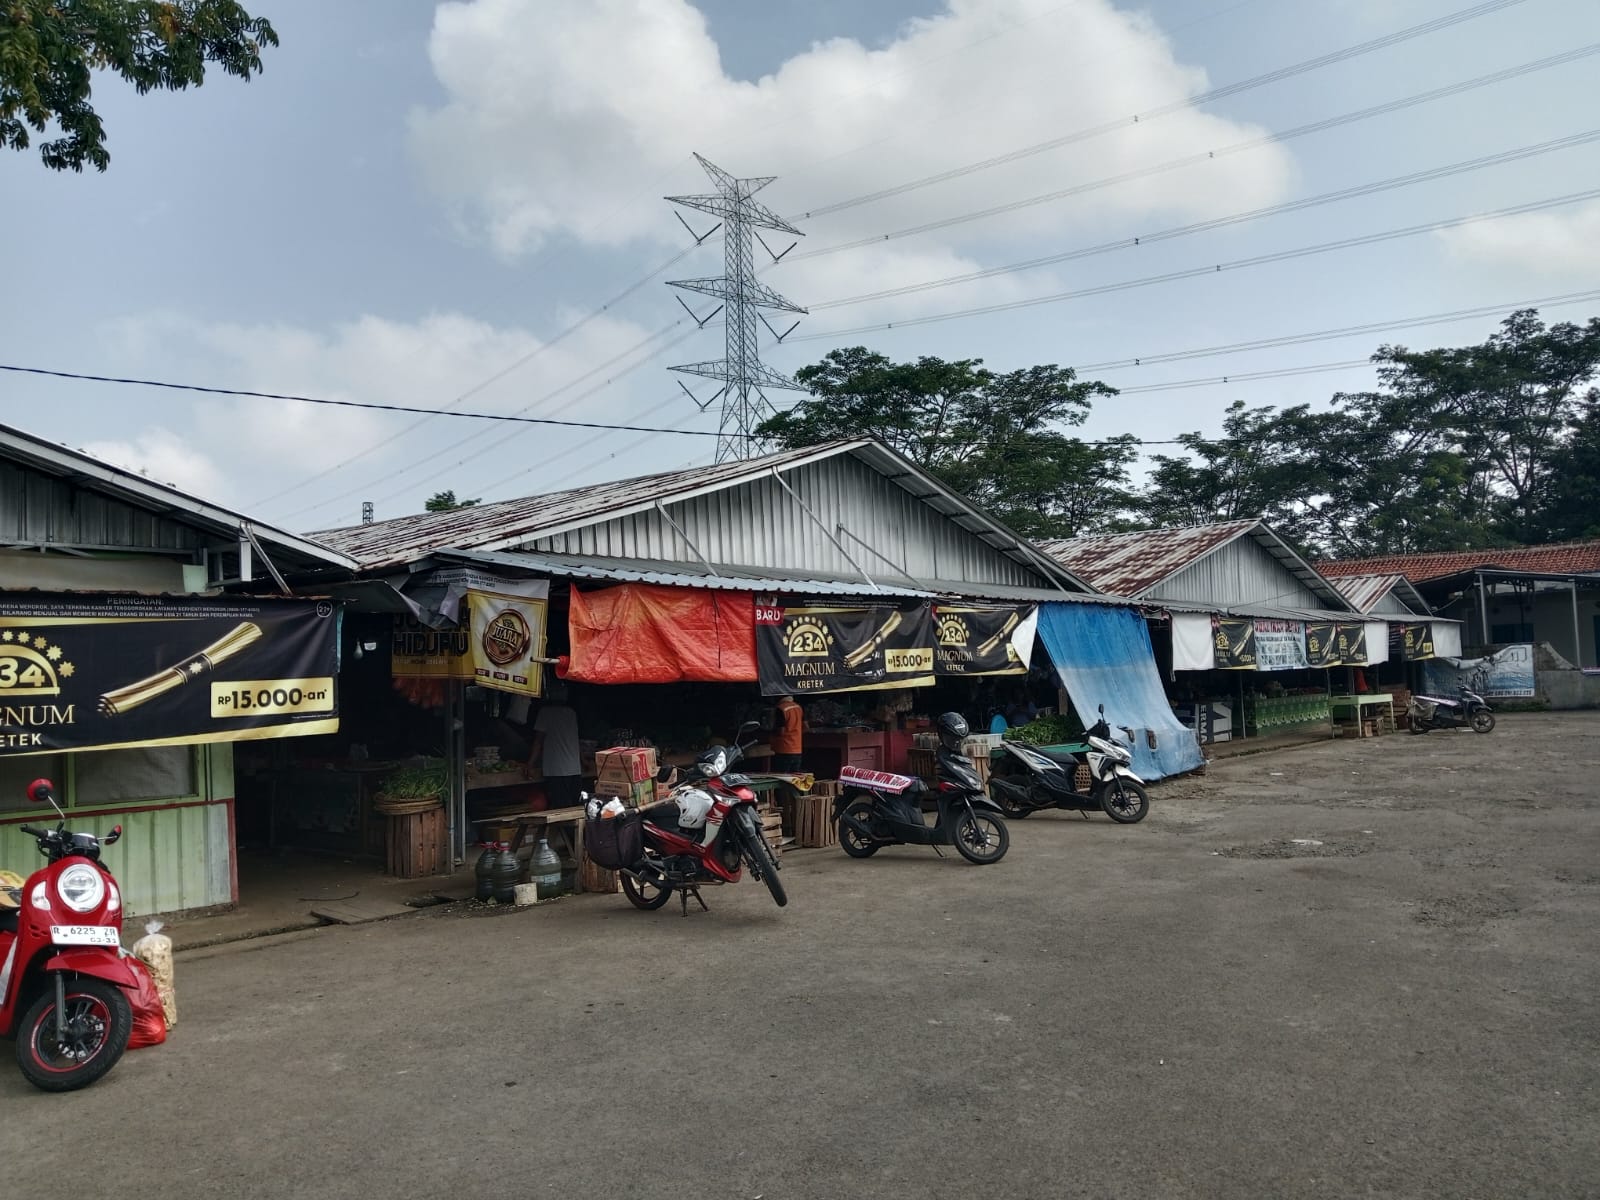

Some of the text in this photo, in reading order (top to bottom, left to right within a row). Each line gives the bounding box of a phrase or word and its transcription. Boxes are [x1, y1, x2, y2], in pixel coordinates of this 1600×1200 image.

[756, 609, 781, 621] BARU
[793, 631, 823, 652] 234
[937, 650, 973, 662] MAGNUM
[784, 662, 836, 677] MAGNUM
[797, 680, 825, 688] KRETEK
[0, 704, 76, 727] NUM
[70, 927, 96, 935] 6225
